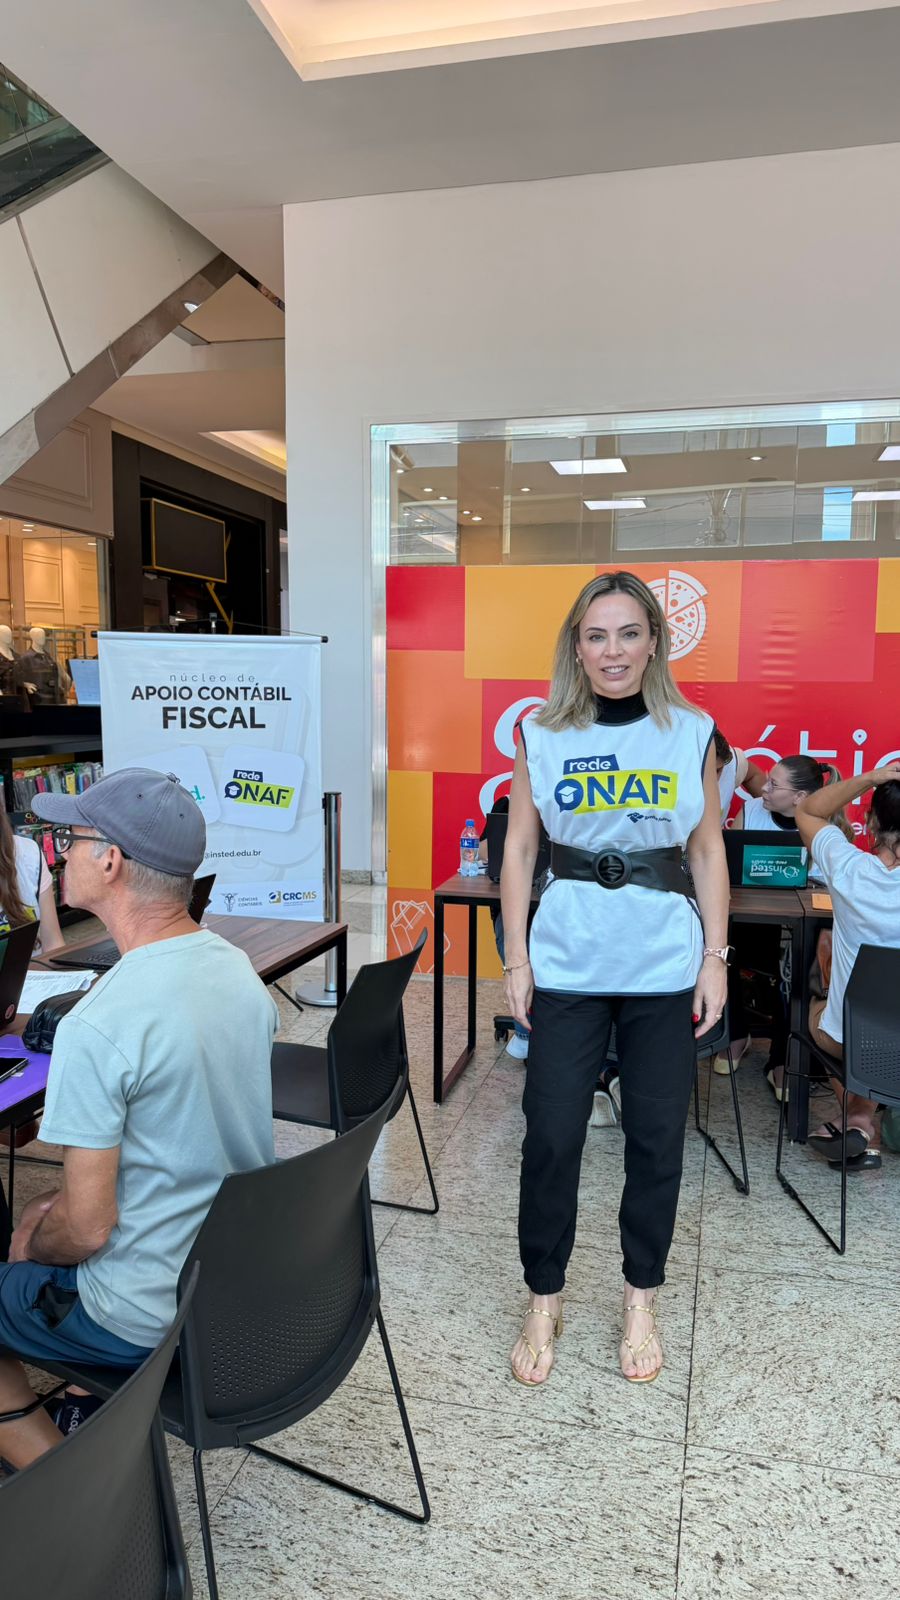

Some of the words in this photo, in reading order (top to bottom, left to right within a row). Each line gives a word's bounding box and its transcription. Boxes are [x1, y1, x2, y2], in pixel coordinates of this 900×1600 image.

[169, 672, 227, 682] núcleo
[237, 673, 256, 682] de
[131, 686, 193, 701] APOIO
[197, 683, 292, 701] CONTÁBIL
[162, 706, 266, 729] FISCAL
[569, 757, 612, 772] rede
[236, 770, 261, 782] rede
[282, 891, 317, 901] CRCMS
